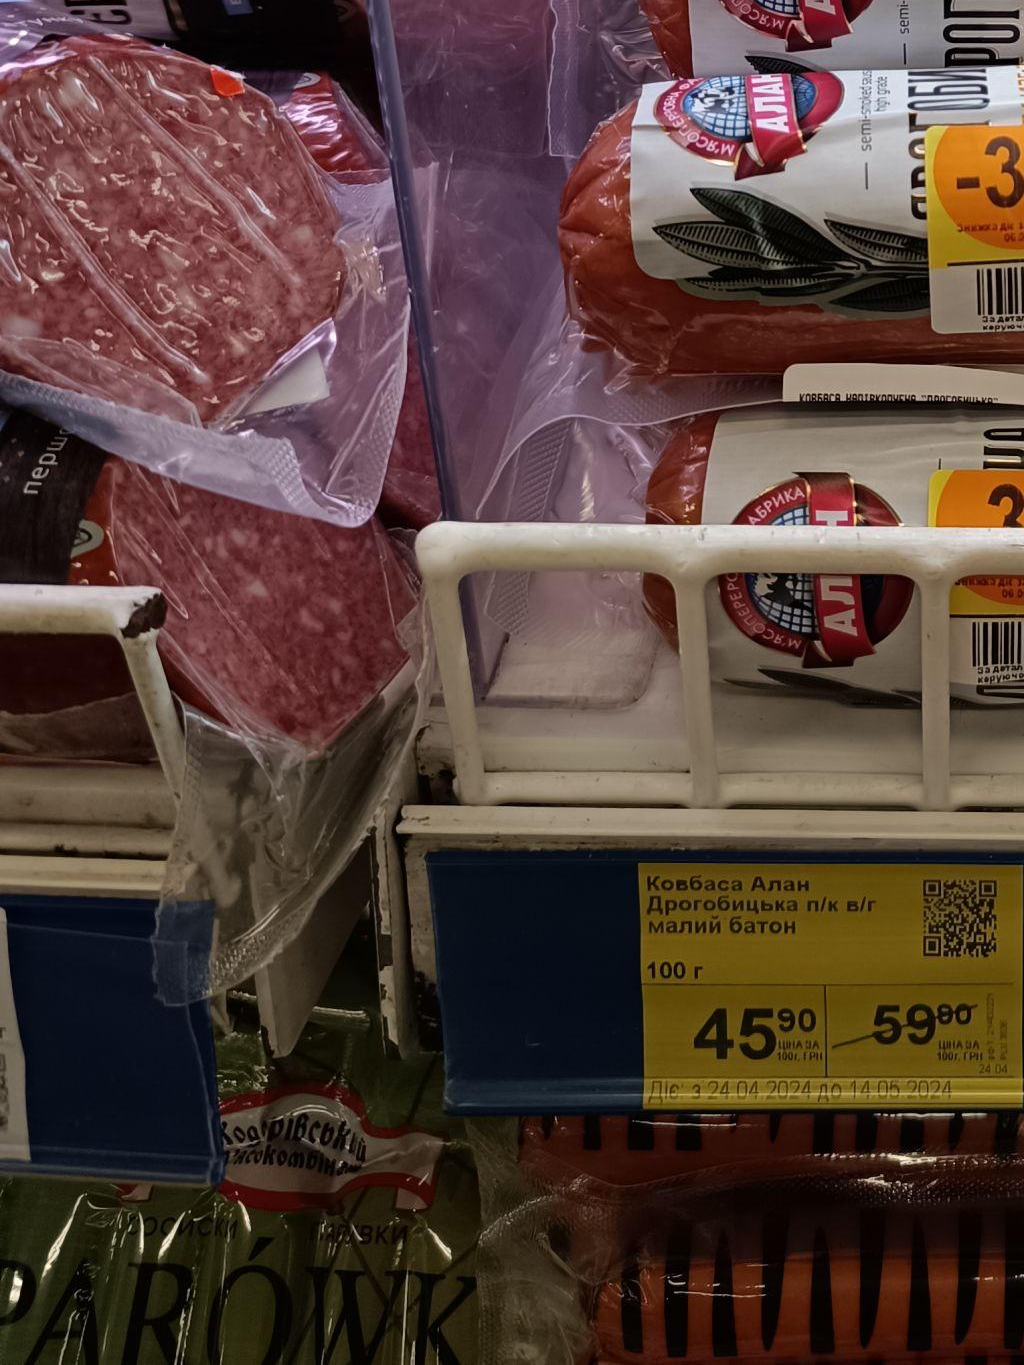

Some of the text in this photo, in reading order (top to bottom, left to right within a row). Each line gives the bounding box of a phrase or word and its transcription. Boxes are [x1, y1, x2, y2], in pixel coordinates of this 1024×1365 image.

[23, 428, 73, 496] перш
[646, 875, 810, 892] Ковбаса Алан
[647, 896, 876, 916] Дрогобицька п/к в/г
[649, 916, 796, 934] малий батон
[647, 962, 703, 979] 100 г
[694, 1007, 817, 1060] 45 90
[691, 1084, 701, 1099] з
[817, 1083, 842, 1103] до
